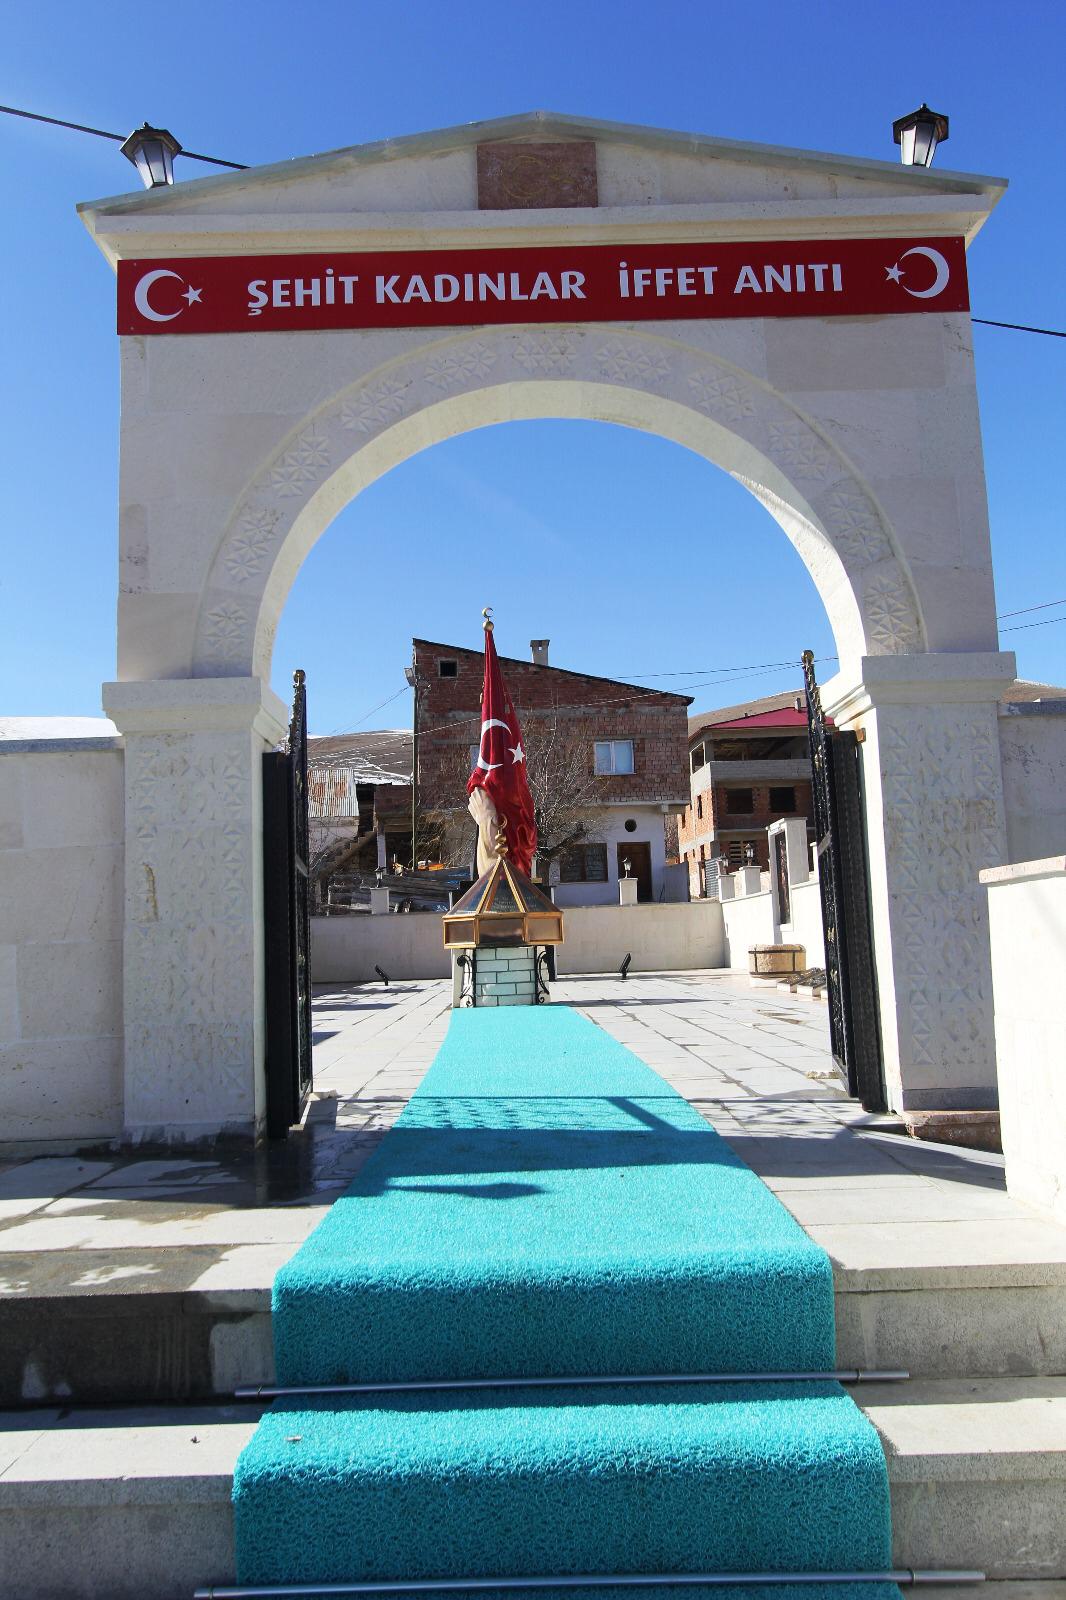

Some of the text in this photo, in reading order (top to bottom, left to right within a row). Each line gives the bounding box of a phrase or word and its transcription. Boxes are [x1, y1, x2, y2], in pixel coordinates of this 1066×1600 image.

[247, 261, 843, 316] ŞEHİT KADINLAR İFFET ANITI
